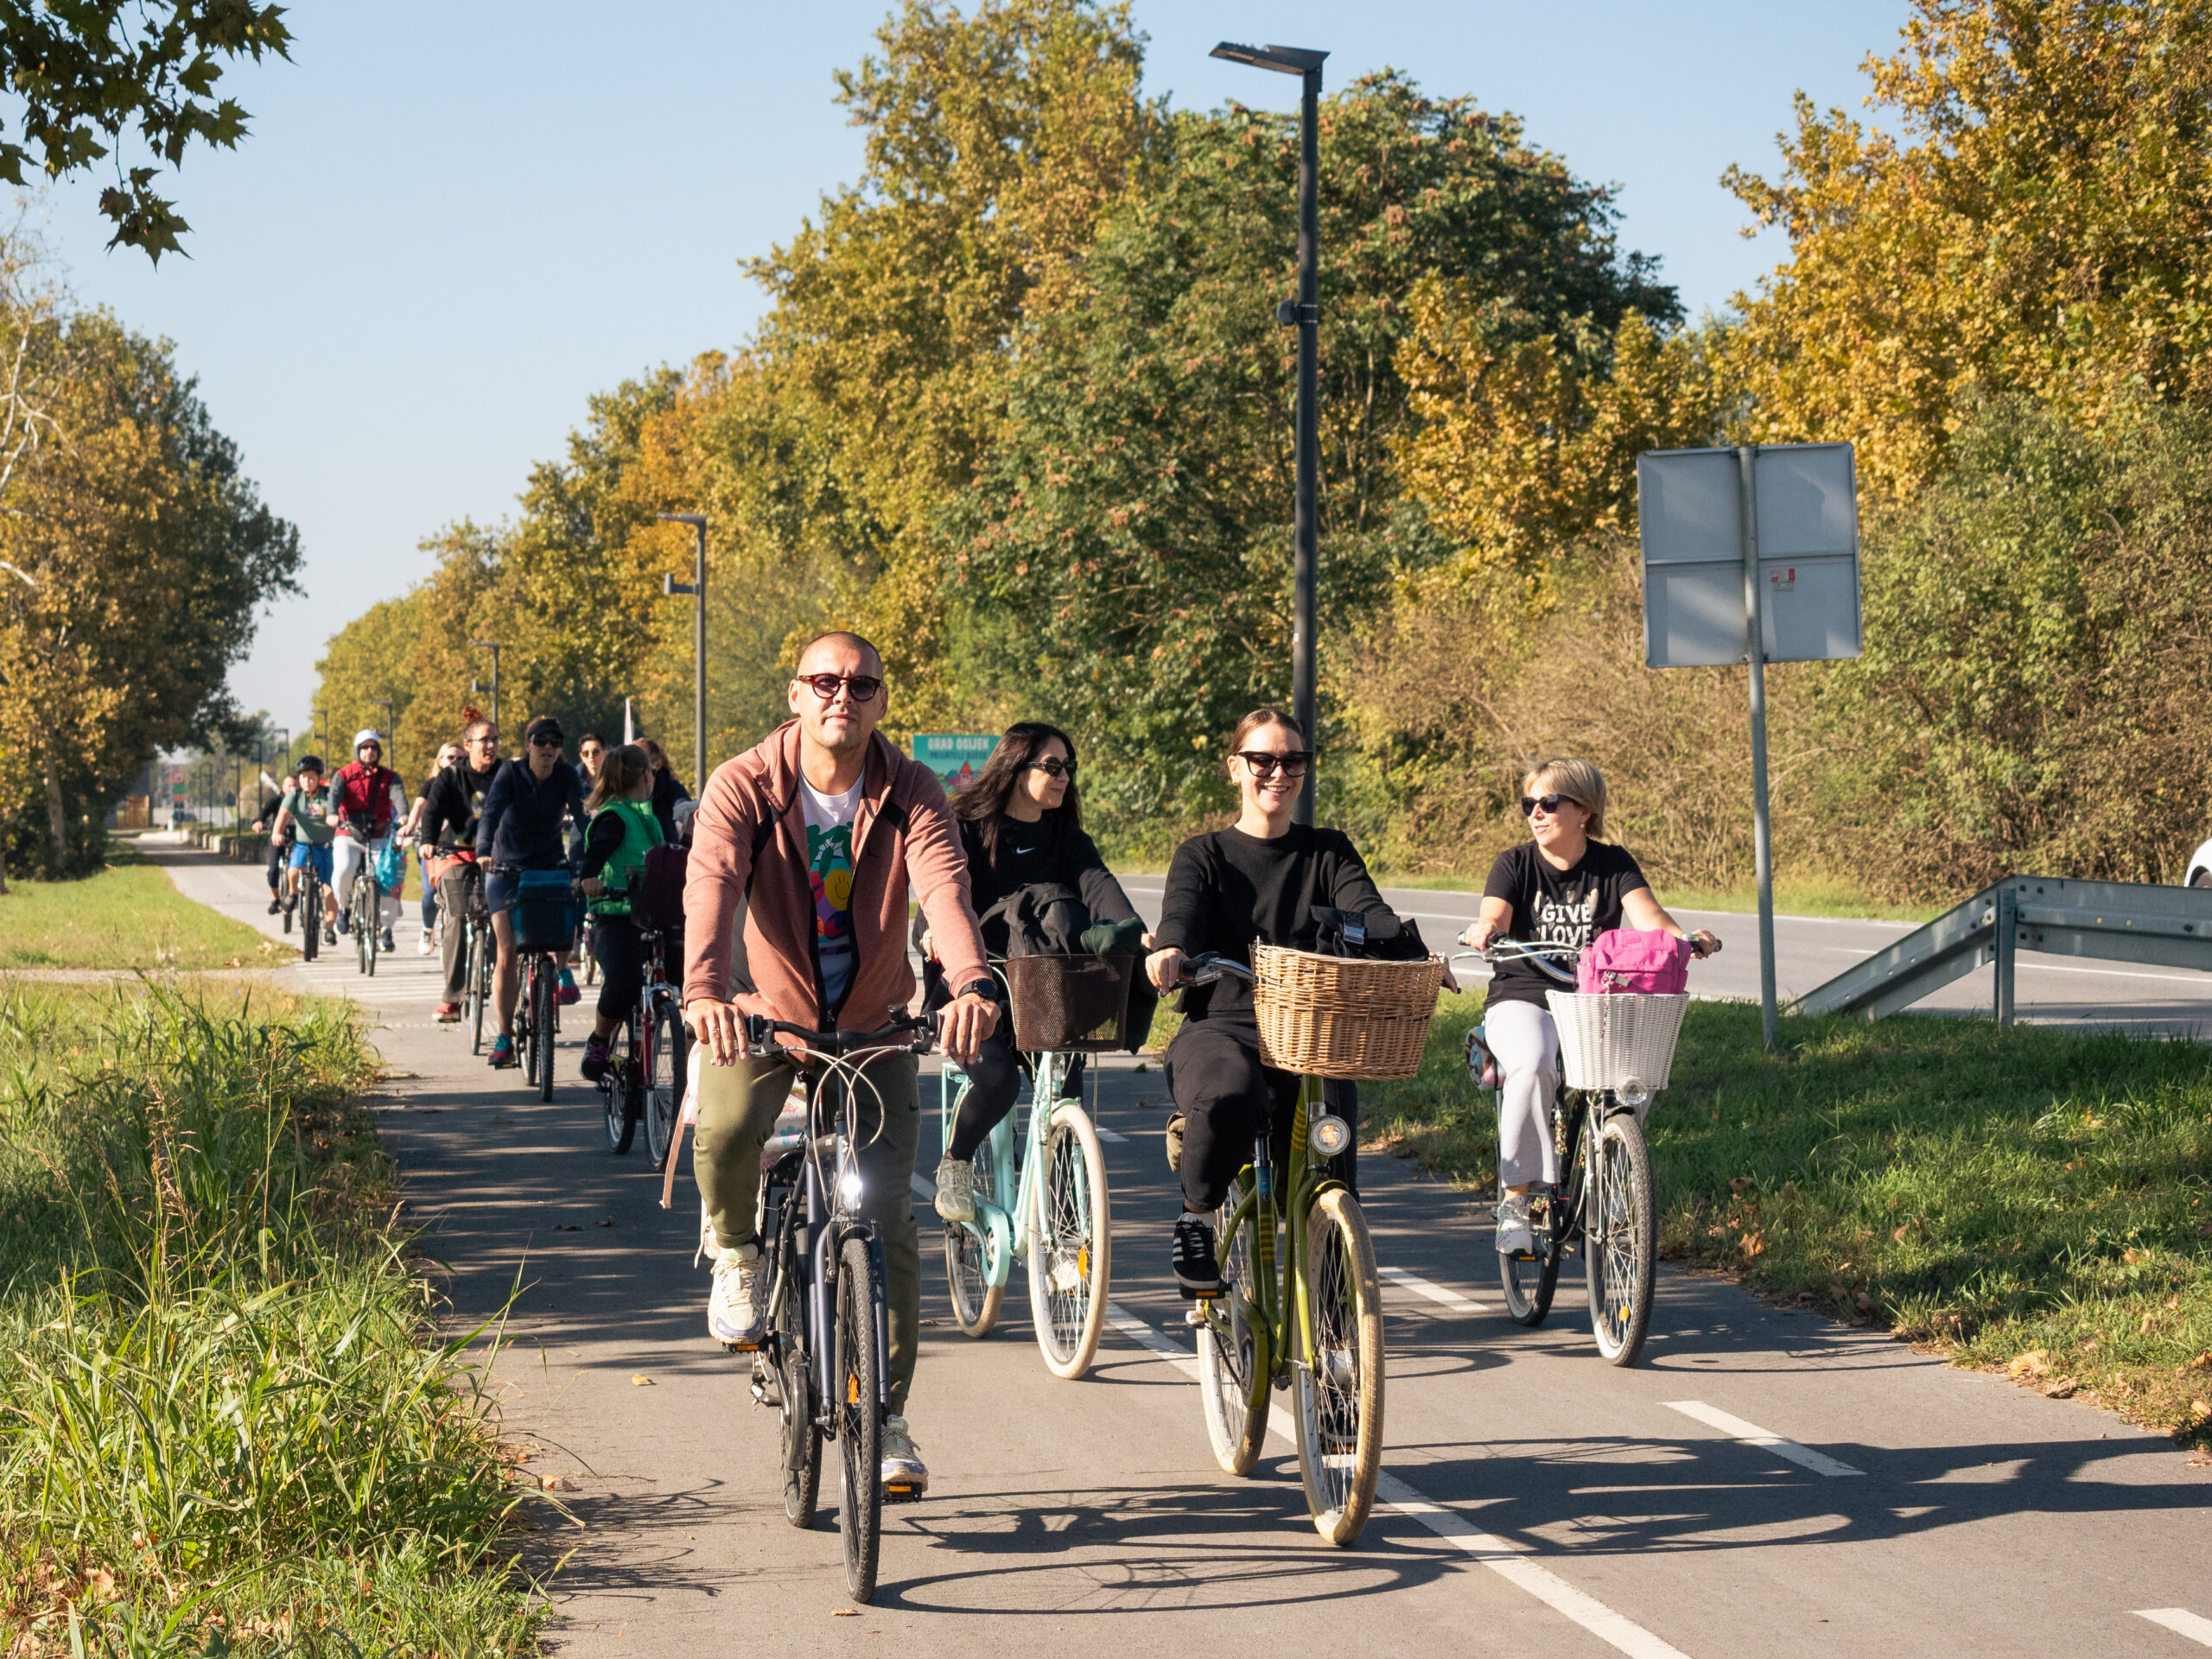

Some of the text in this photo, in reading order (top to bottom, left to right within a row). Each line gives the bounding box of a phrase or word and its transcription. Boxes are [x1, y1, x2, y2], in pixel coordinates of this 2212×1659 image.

[928, 737, 989, 751] GRAD OSIJEK
[1541, 904, 1592, 924] GIVE
[1541, 925, 1592, 947] LOVE
